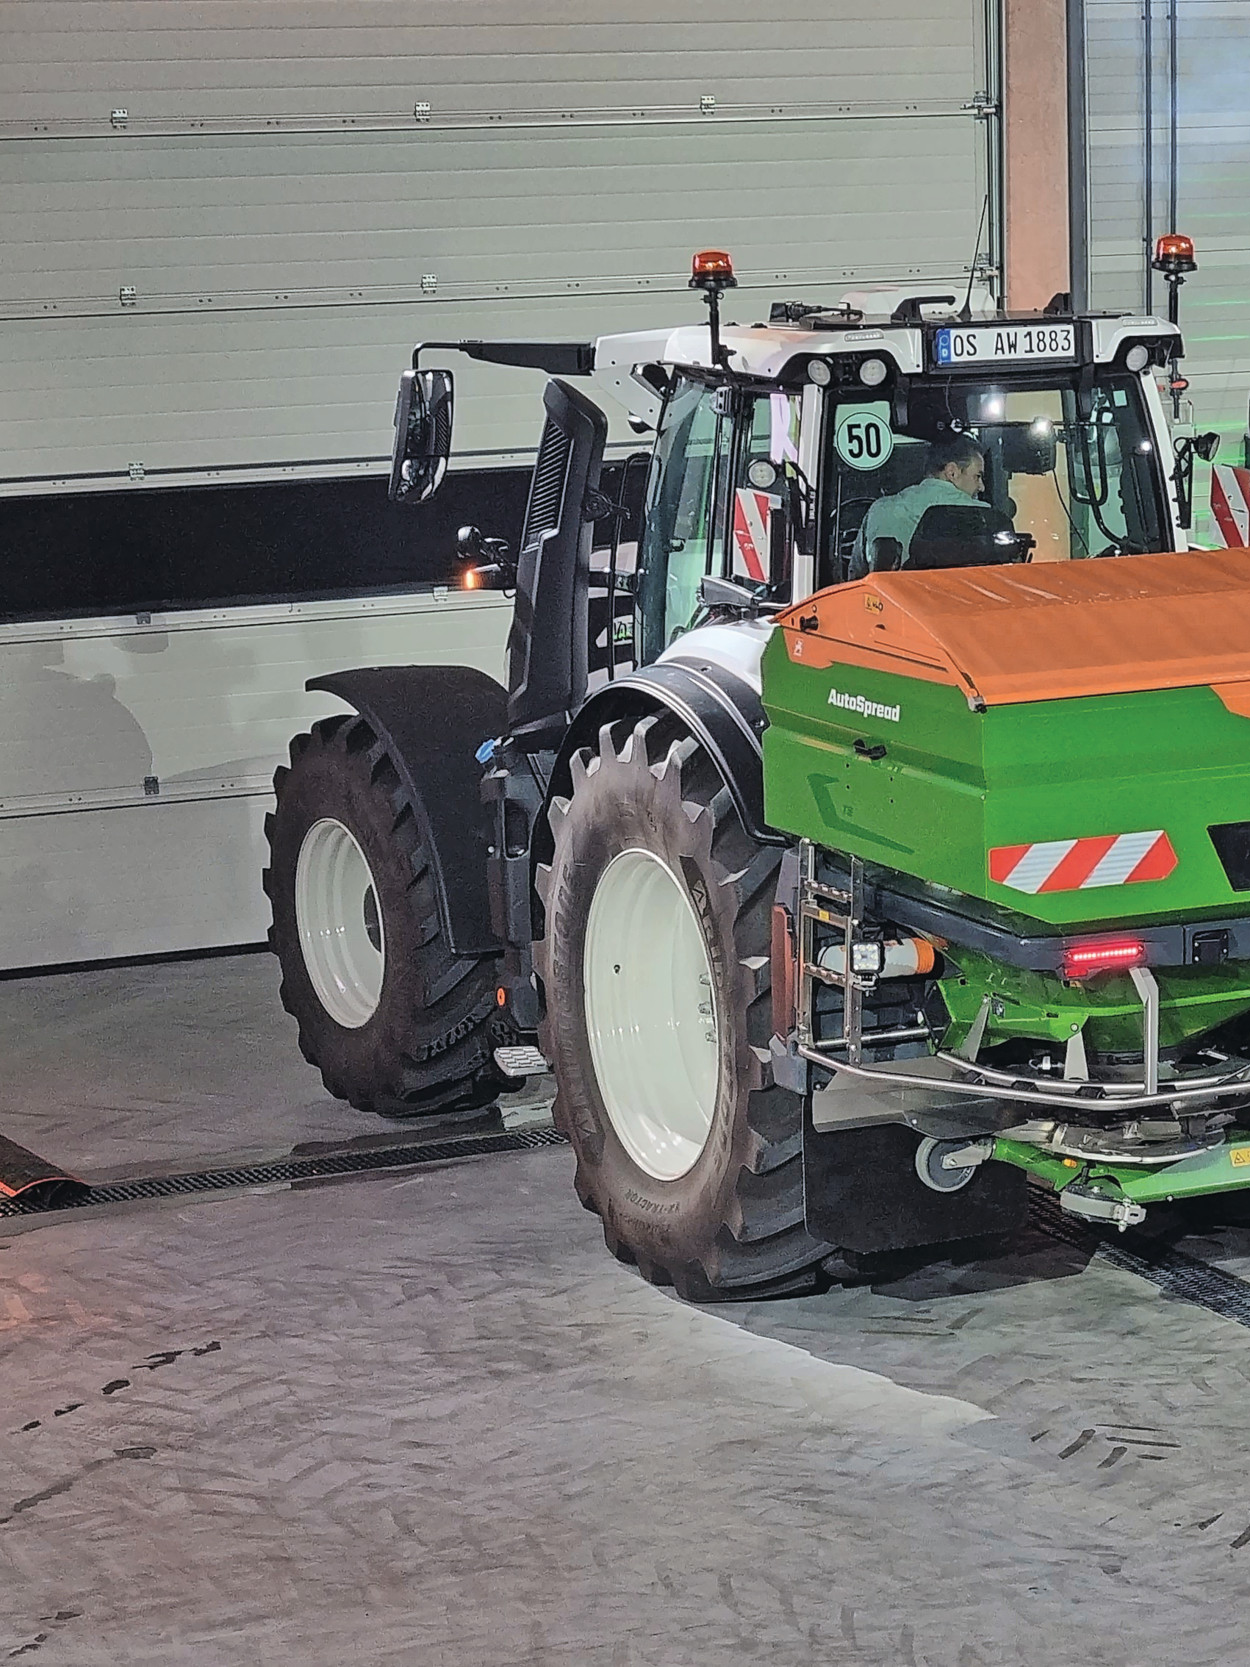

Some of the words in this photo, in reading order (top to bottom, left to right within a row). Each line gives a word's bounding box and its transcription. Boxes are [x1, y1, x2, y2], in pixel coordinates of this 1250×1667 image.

[953, 334, 977, 357] OS
[994, 331, 1018, 355] AW
[1023, 329, 1071, 354] 1883
[847, 422, 882, 459] 50
[827, 688, 901, 722] AutoSpread
